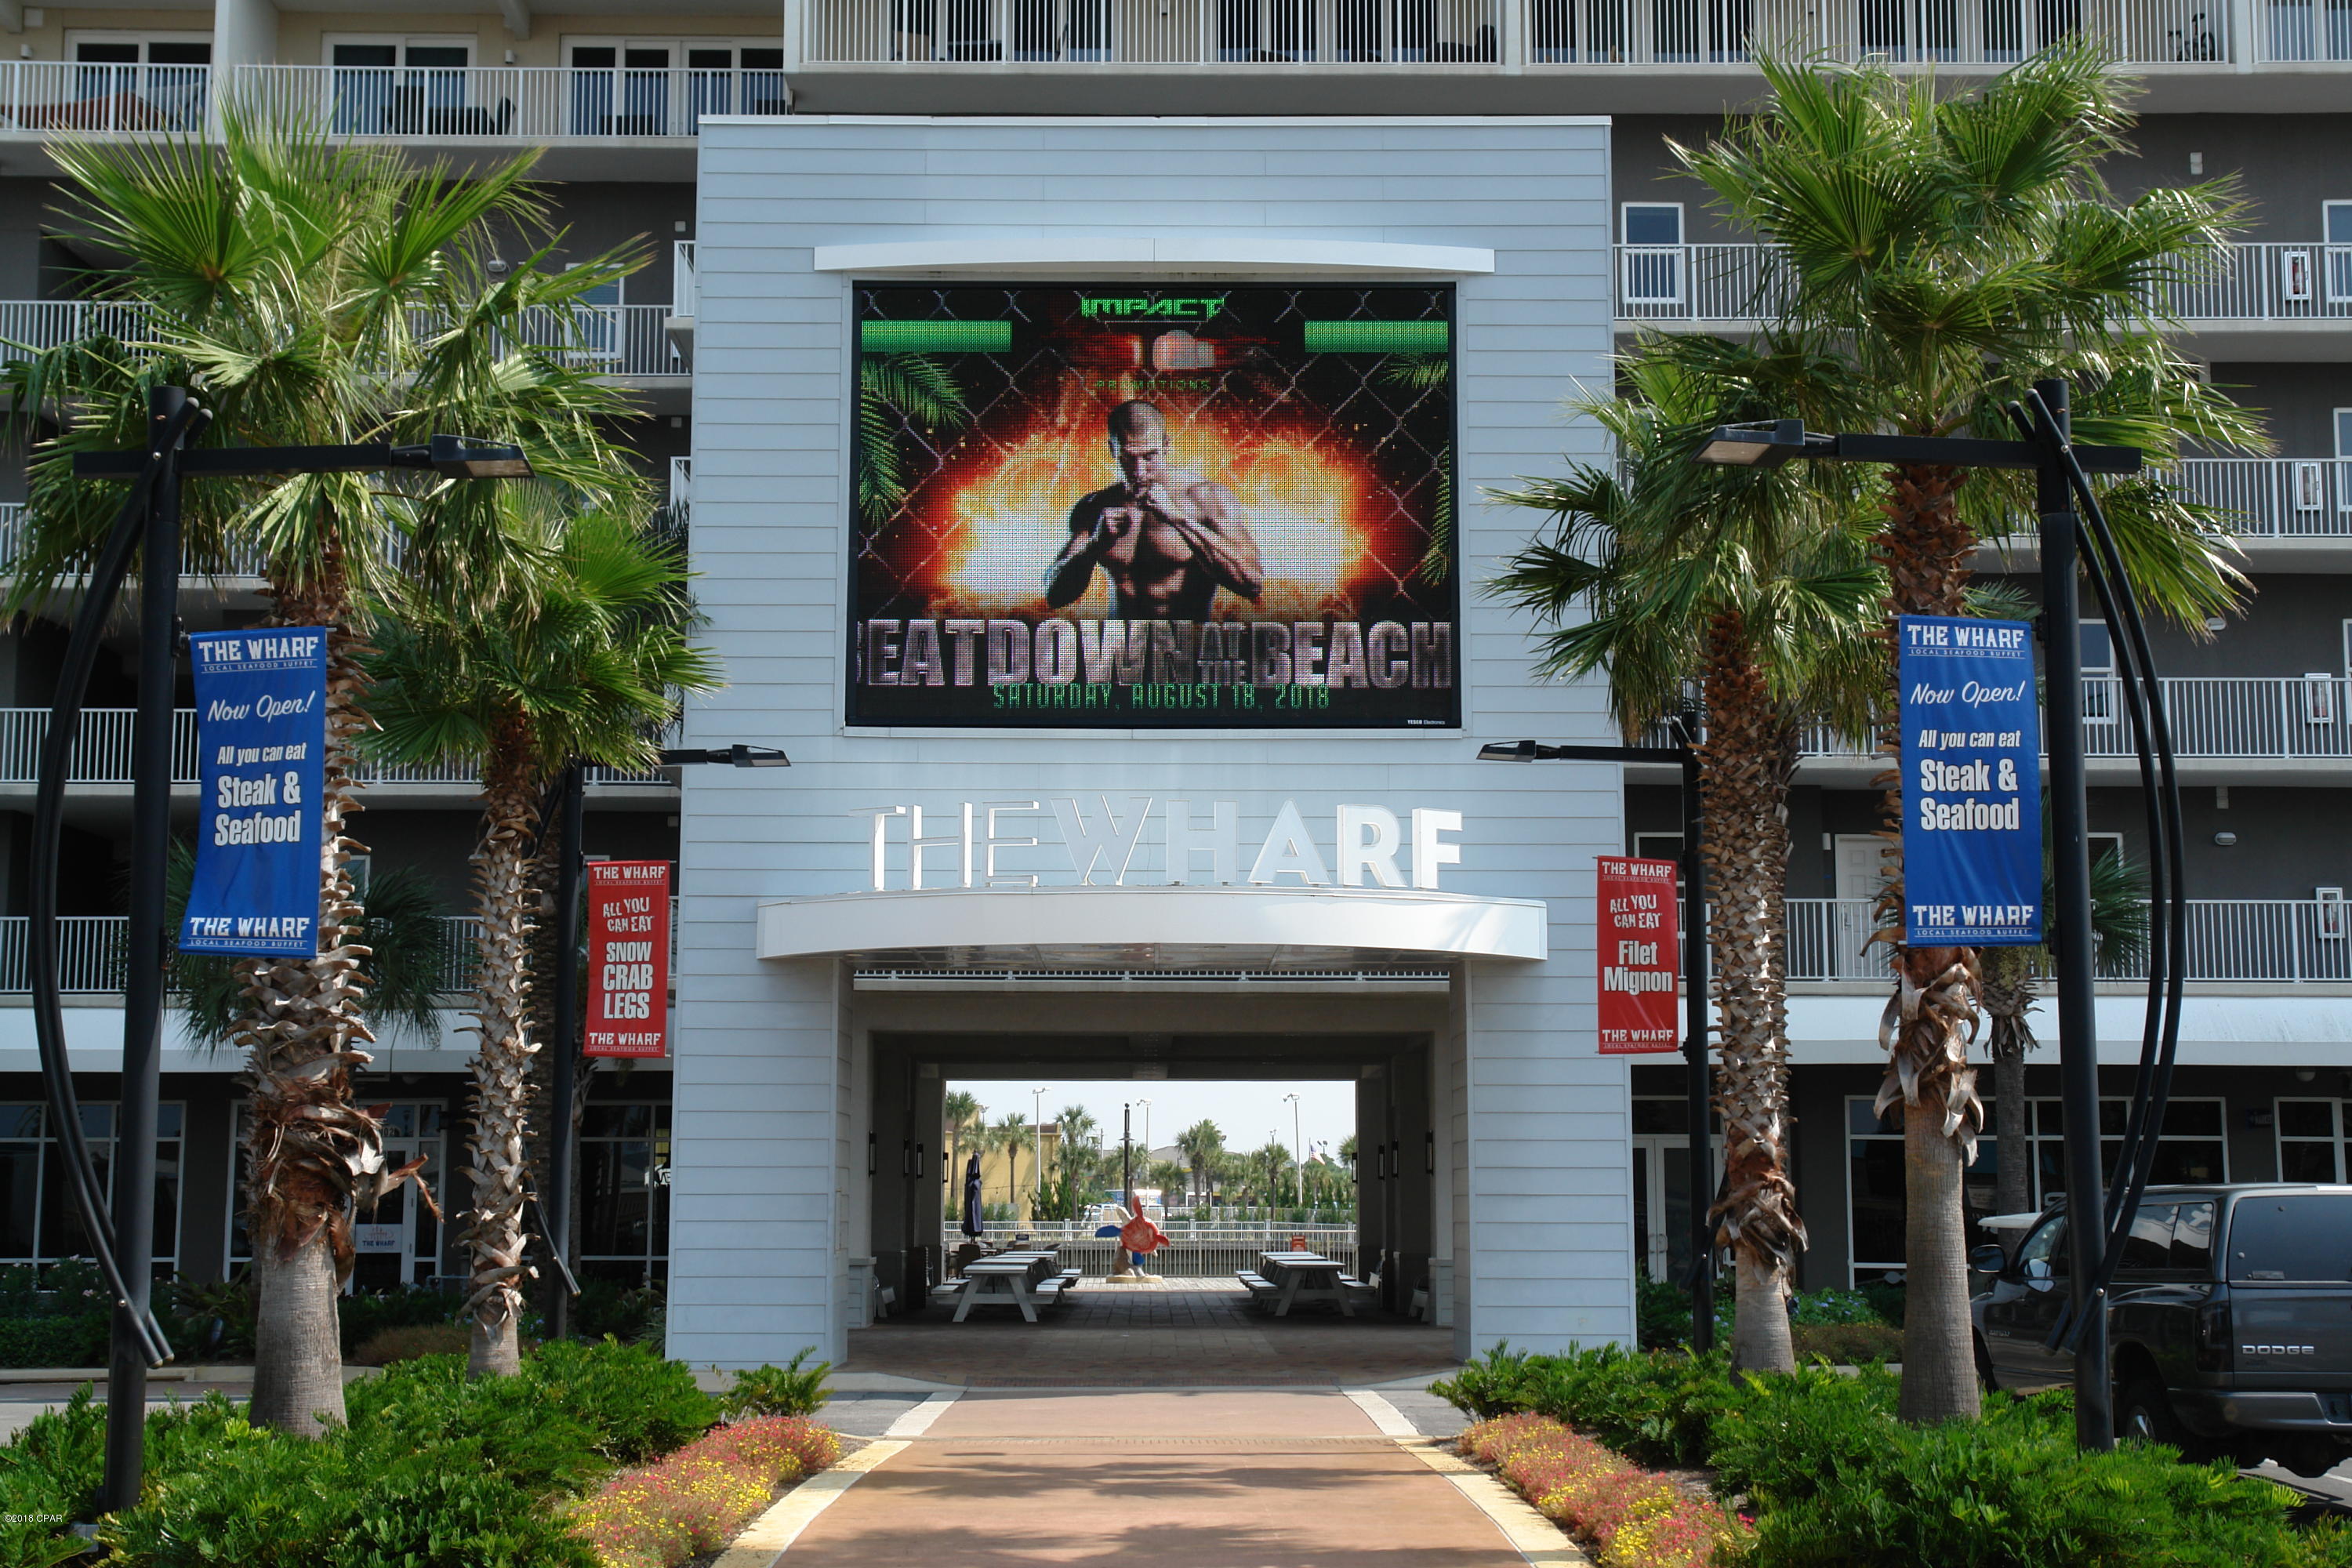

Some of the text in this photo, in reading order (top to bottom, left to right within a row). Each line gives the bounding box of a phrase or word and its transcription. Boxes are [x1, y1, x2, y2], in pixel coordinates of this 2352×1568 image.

[1081, 297, 1224, 318] IMPACT
[1907, 625, 2024, 648] THE WHARF
[198, 637, 319, 662] THE WHARF
[857, 619, 1192, 687] EATDOWN
[1200, 622, 1247, 659] AT
[1252, 621, 1451, 688] BEACH
[238, 662, 278, 670] SEAFOOD
[1132, 683, 1221, 709] AUGUST
[1276, 683, 1329, 709] 2018
[1910, 680, 2026, 709] Now Open!
[207, 690, 316, 723] Now Open!
[1918, 730, 2020, 751] All you can eat
[216, 742, 307, 767] All you can eat
[1920, 758, 2018, 792] Steak &
[217, 771, 301, 808] Steak &
[1920, 797, 2020, 830] Seafood
[214, 810, 301, 846] Seafood
[848, 793, 1463, 891] THE WHARF
[593, 866, 666, 879] THE WHARF
[1602, 862, 1671, 877] THE WHARF
[603, 897, 650, 917] ALL YOU
[1610, 895, 1657, 913] ALL YOU
[189, 917, 310, 938] THE WHARF
[607, 916, 654, 932] CAN EAT
[1614, 913, 1660, 929] CAN EAT
[1912, 906, 2034, 926] THE WHARF
[606, 942, 652, 963] SNOW
[1619, 940, 1658, 965] Filet
[603, 964, 653, 991] CRAB
[1603, 966, 1673, 996] Mignon
[604, 992, 650, 1019] LEGS
[589, 1033, 661, 1046] THE WHARF
[1602, 1029, 1674, 1042] THE WHARF
[2242, 1345, 2315, 1355] DODGE
